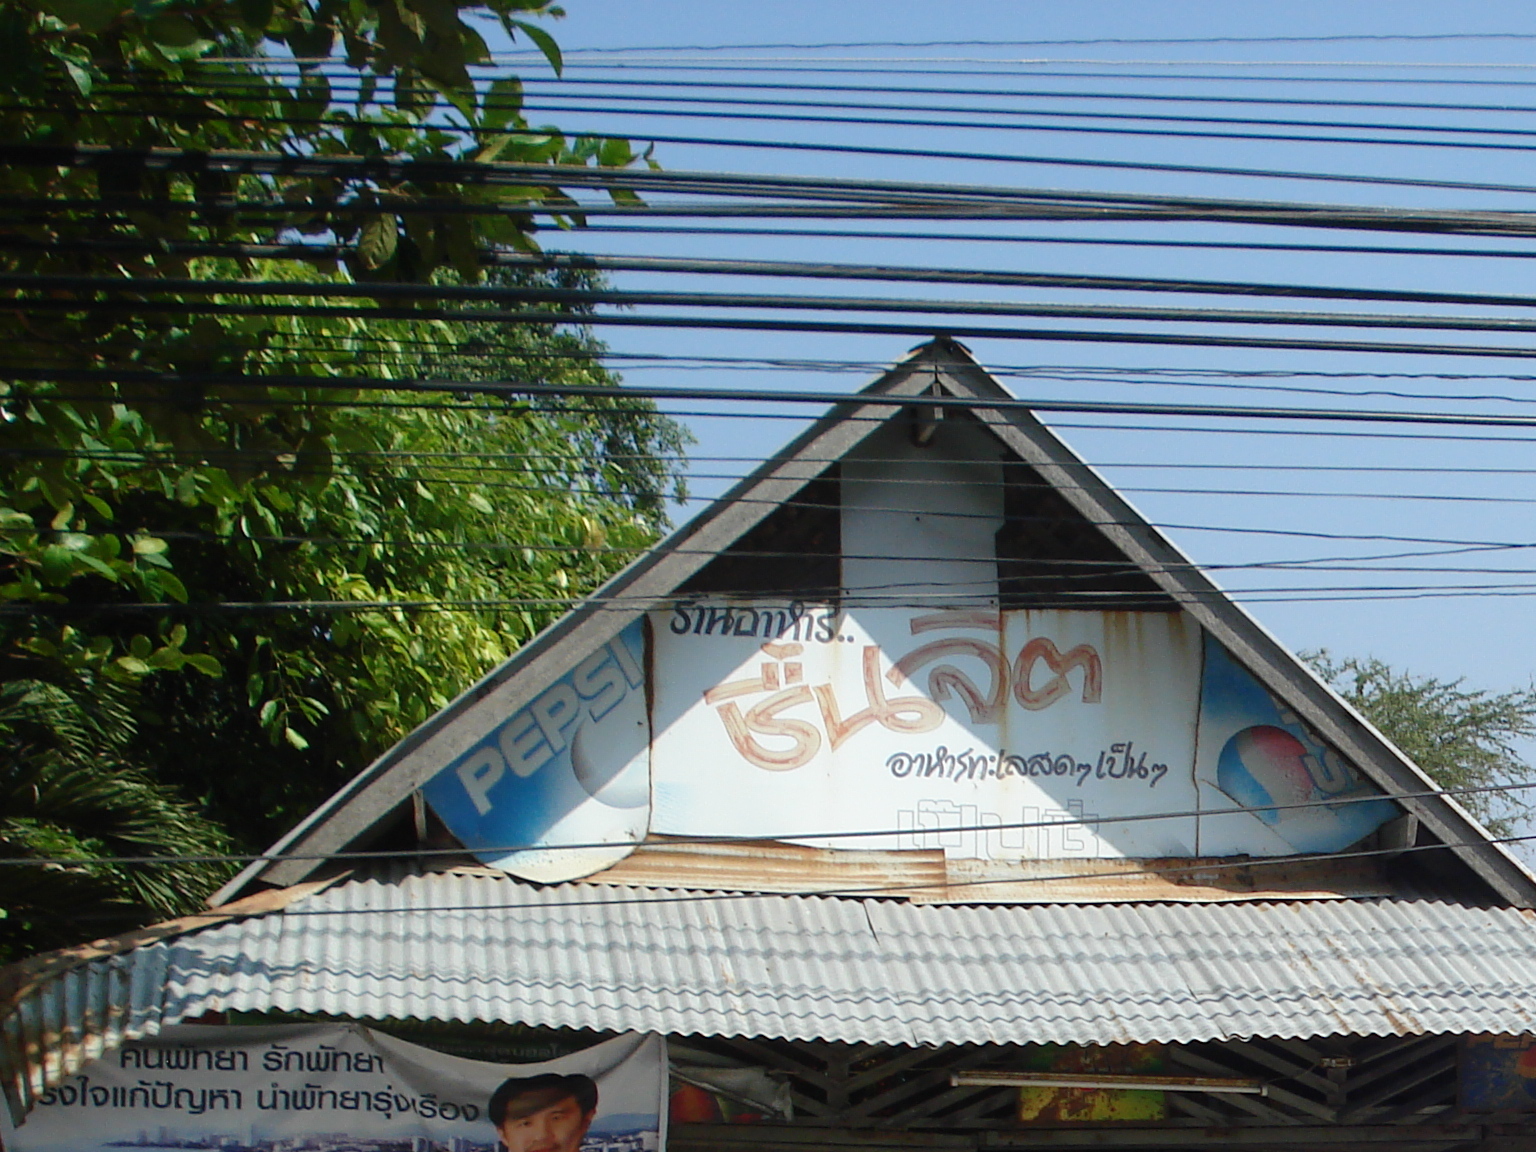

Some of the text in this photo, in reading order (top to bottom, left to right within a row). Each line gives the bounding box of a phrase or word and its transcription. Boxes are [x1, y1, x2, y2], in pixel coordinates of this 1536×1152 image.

[455, 634, 645, 817] PEPSI
[119, 1042, 384, 1074] คนพัทยา รักพัทยา
